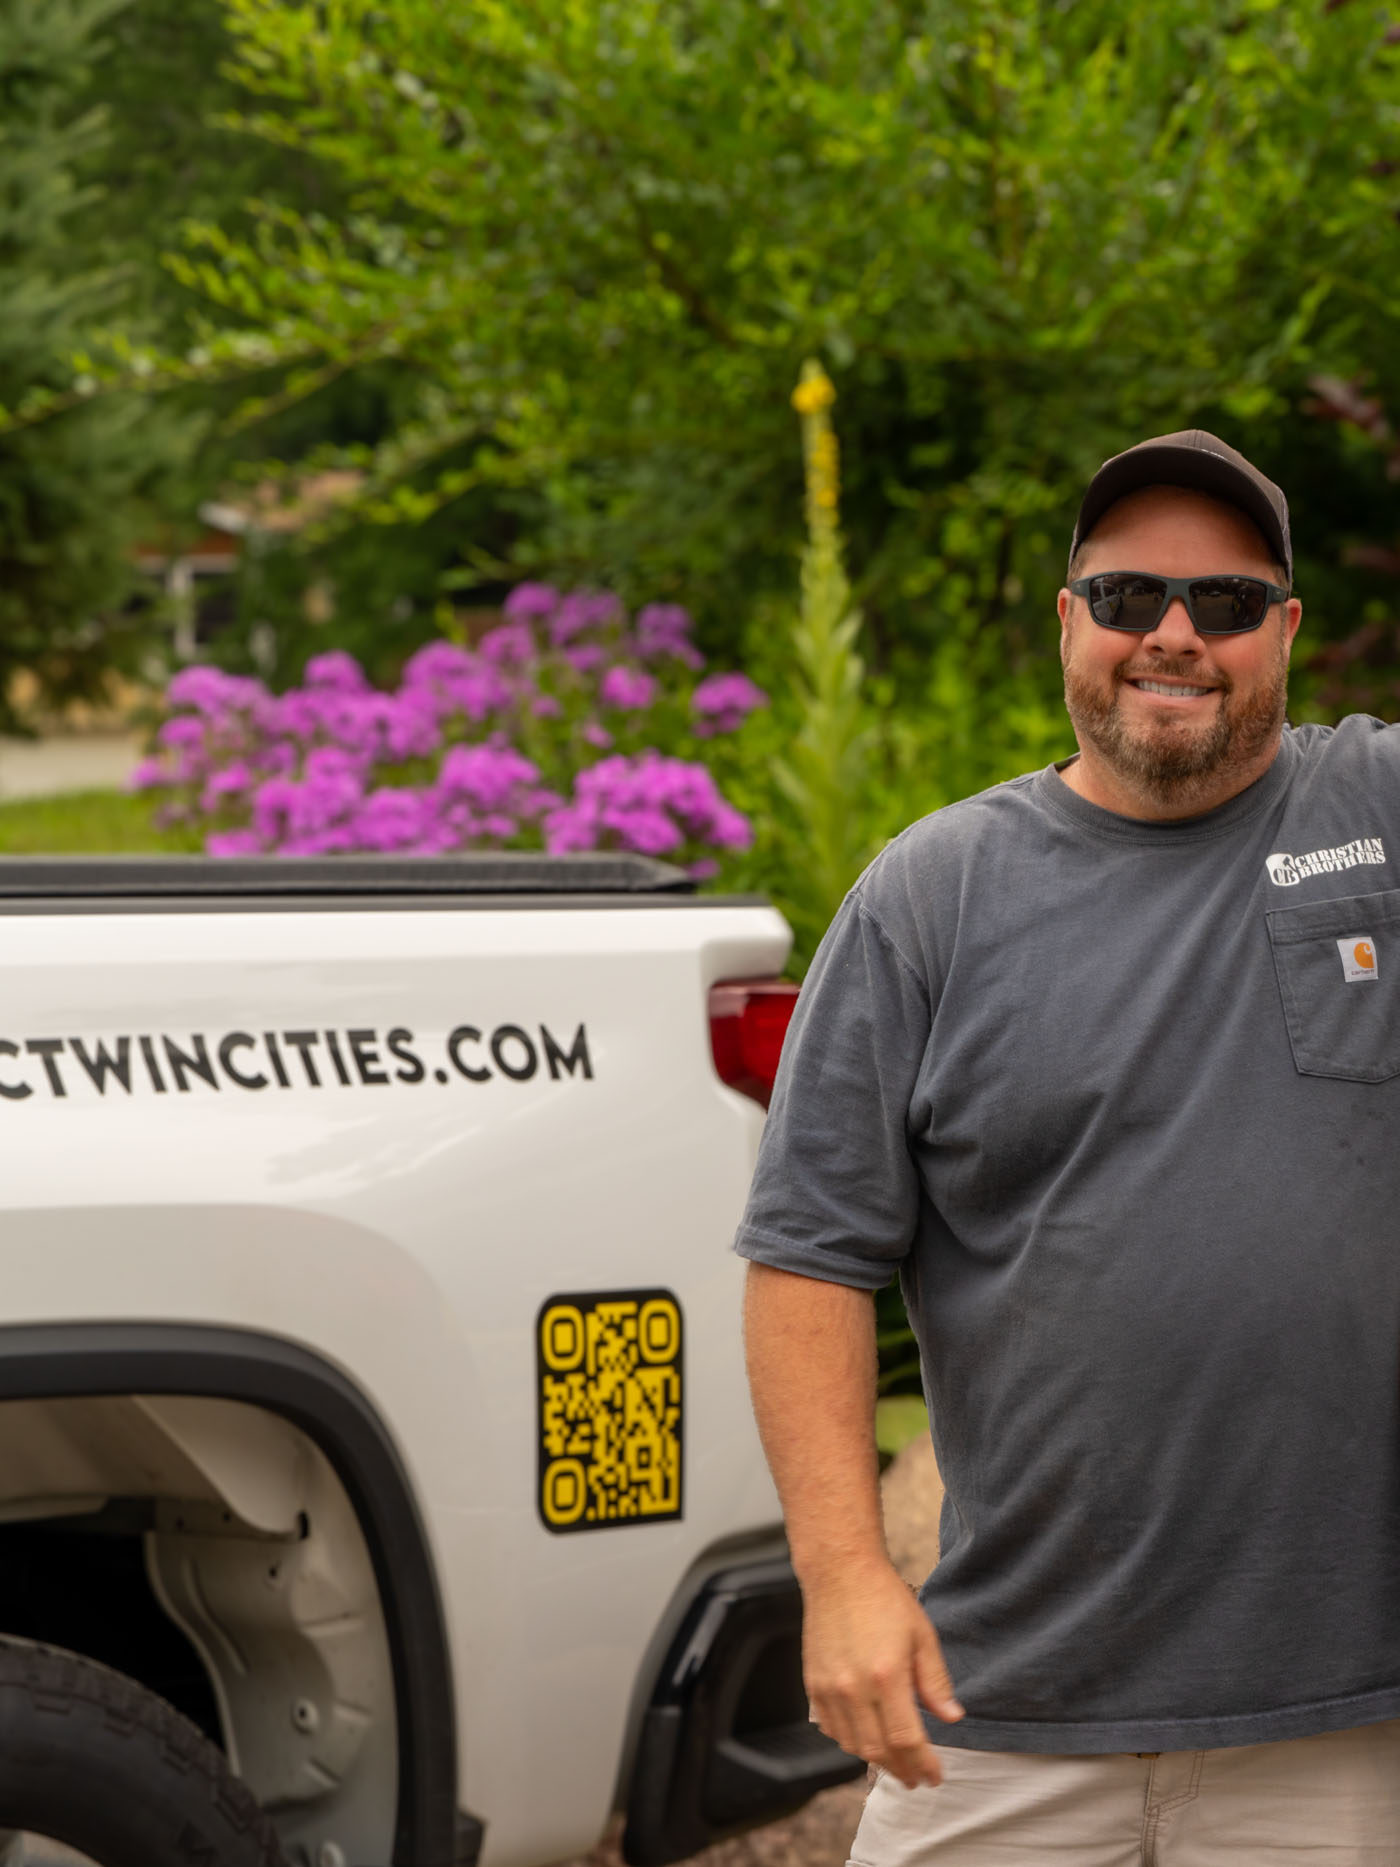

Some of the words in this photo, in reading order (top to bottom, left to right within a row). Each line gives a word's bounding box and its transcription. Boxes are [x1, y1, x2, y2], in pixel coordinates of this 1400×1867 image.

[1294, 838, 1383, 867] CHRISTIAN
[1299, 851, 1386, 878] BROTHERS
[1273, 867, 1296, 884] CB
[0, 1022, 595, 1099] CTWINCITIES.COM
